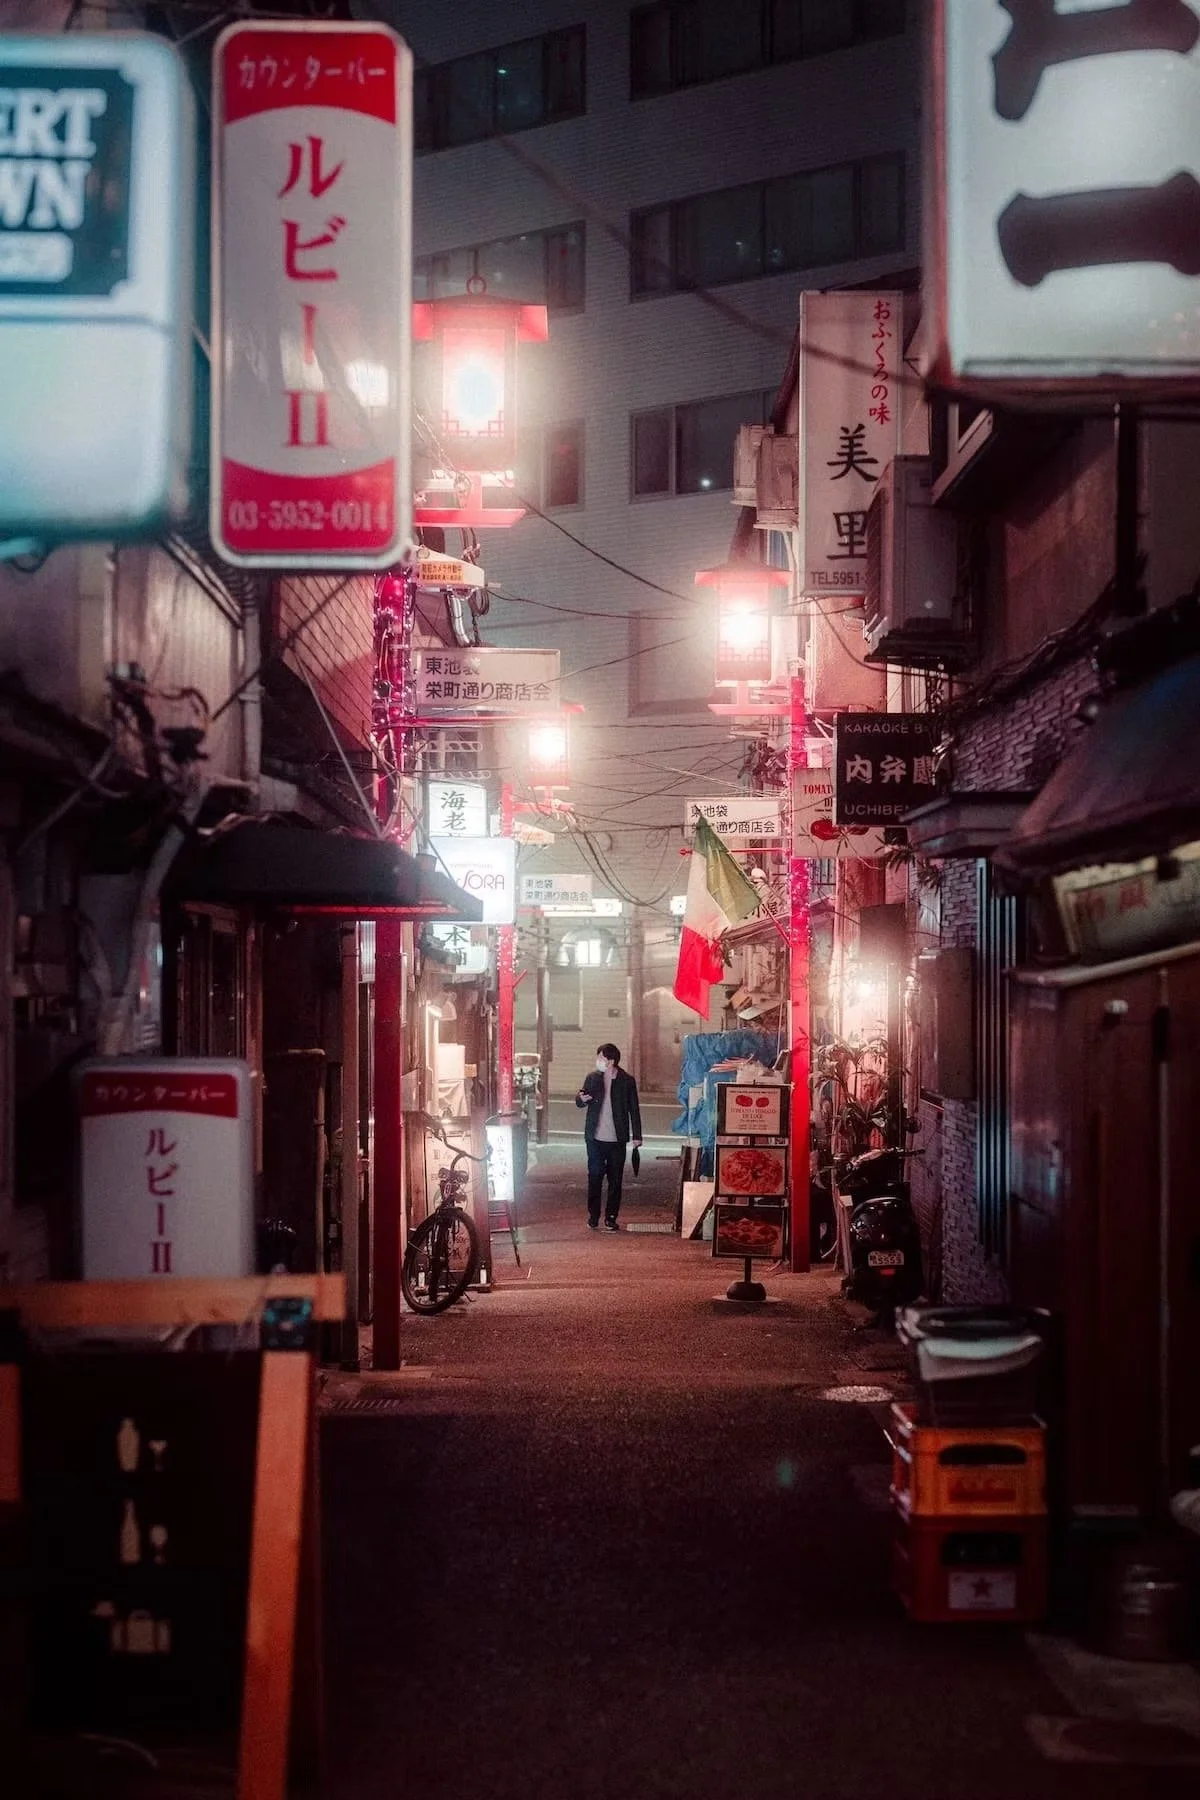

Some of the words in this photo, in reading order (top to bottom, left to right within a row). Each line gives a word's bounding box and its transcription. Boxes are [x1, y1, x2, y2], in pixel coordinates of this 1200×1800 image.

[868, 300, 893, 425] おふくろの味
[826, 423, 879, 561] 美里
[425, 656, 481, 676] 東池袋
[425, 681, 552, 701] 栄町通り商店会
[844, 723, 909, 734] KARAOKE
[691, 804, 728, 818] 東池袋
[844, 803, 909, 816] UCHIBE
[691, 821, 775, 834] 通り商店会
